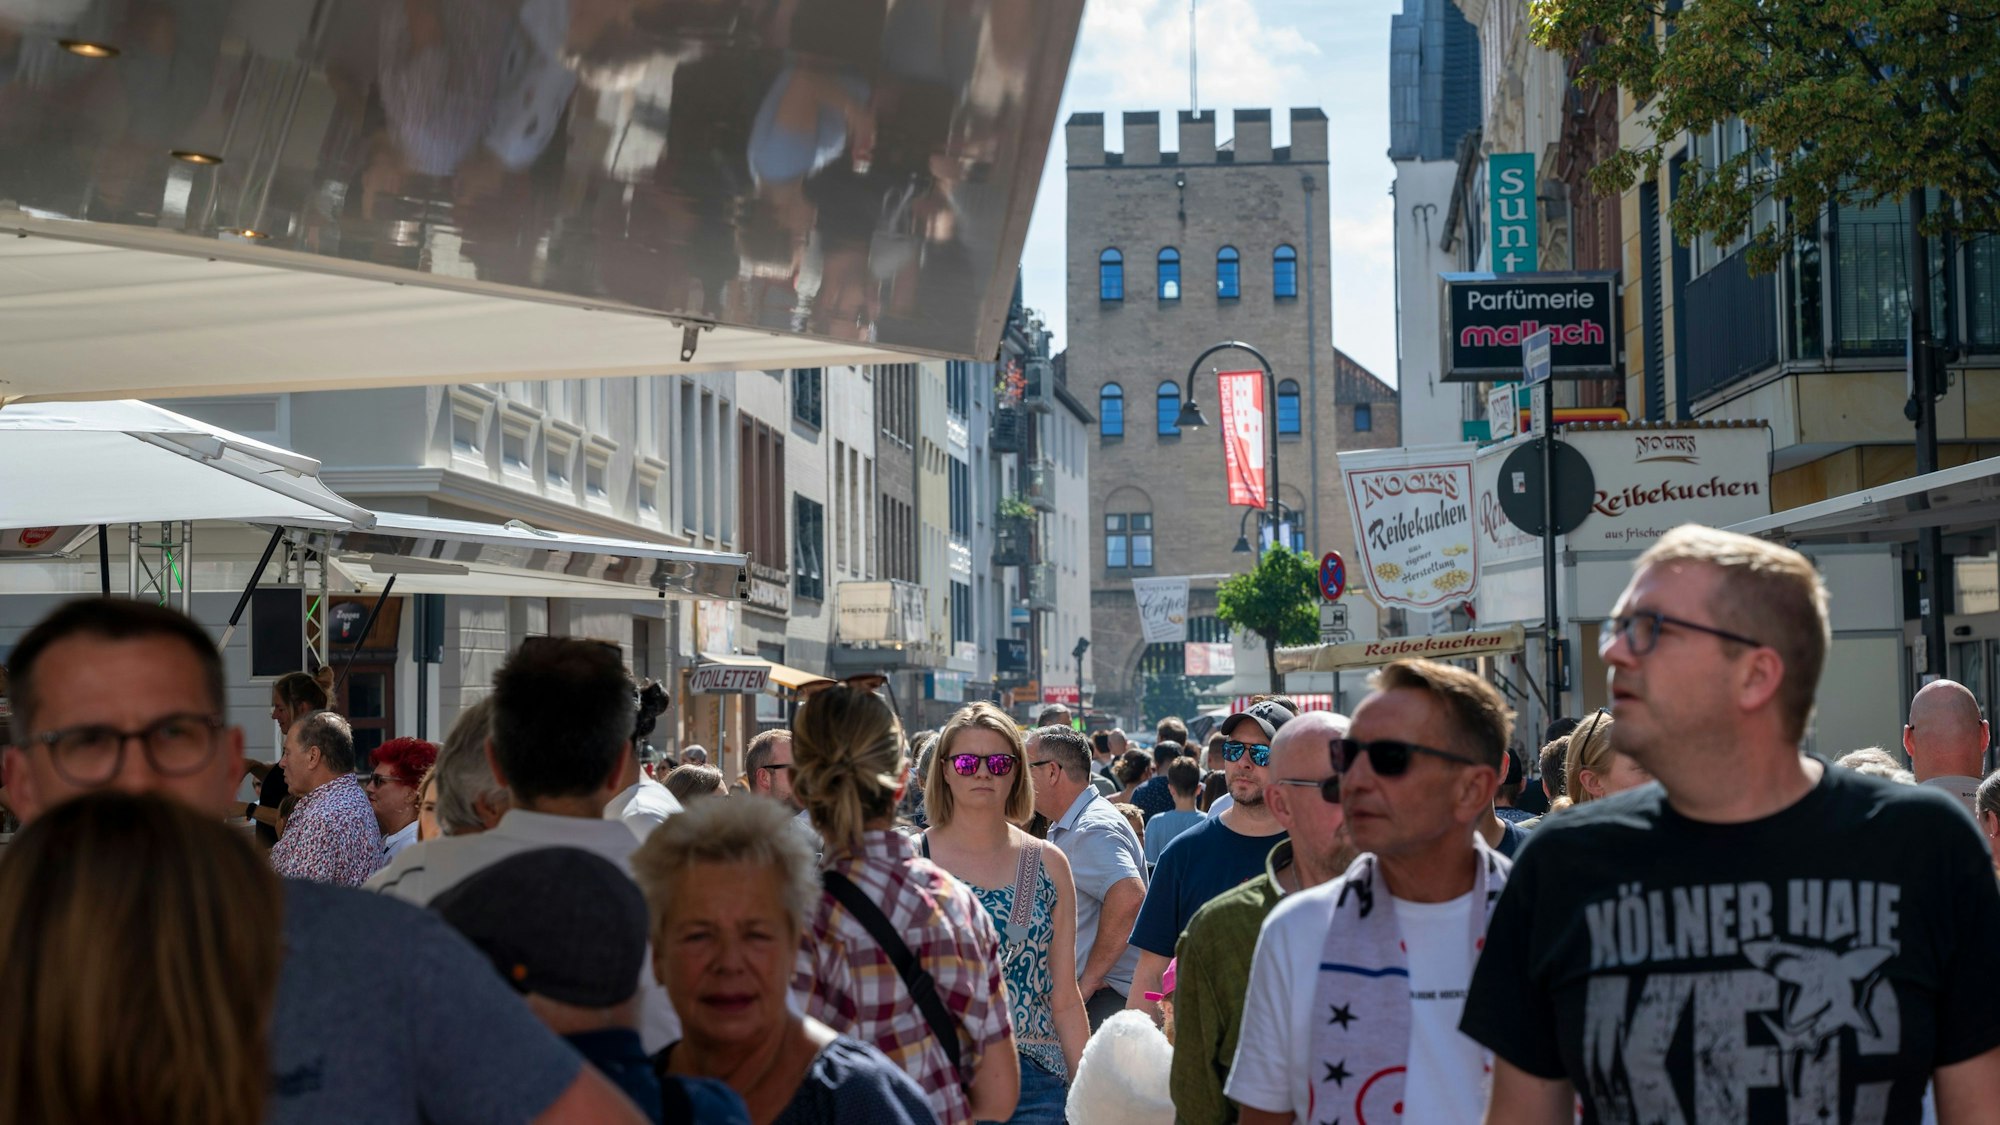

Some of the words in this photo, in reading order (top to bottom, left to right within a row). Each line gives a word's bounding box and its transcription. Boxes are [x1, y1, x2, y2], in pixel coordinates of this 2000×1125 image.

[1468, 289, 1594, 310] Parfümerie
[1461, 319, 1604, 346] mallach
[1593, 476, 1759, 517] Reibekuchen
[1369, 500, 1467, 551] Reibekuchen
[1604, 531, 1624, 539] aus
[1405, 551, 1431, 566] eigener
[1408, 544, 1421, 553] aus
[1402, 559, 1455, 584] Herstellung
[1364, 633, 1502, 657] Reibekuchen
[697, 666, 770, 691] TOILETTEN
[1586, 882, 1773, 969] KÖLNER
[1788, 879, 1902, 953] HAIE
